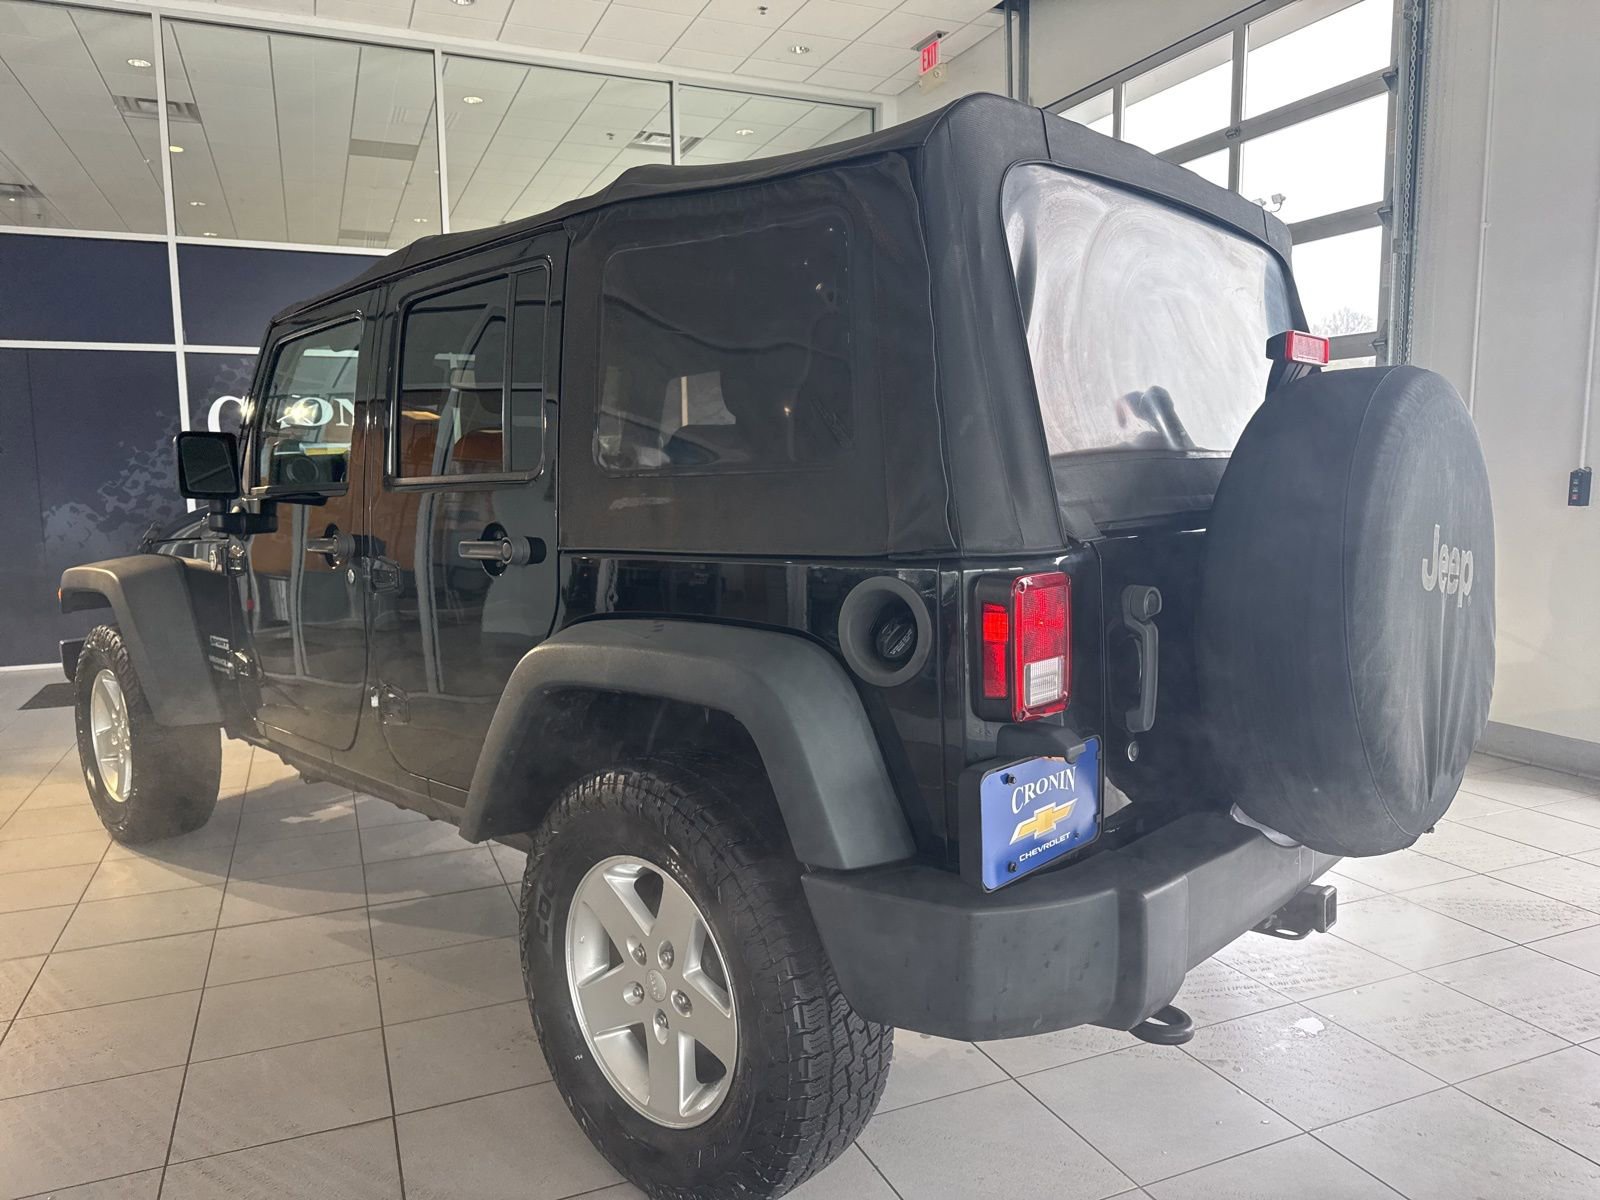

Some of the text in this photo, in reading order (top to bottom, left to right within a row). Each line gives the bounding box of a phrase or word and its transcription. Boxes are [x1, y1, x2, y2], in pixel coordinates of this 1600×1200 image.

[922, 41, 938, 72] EXIT
[1421, 523, 1474, 608] Jeep
[1011, 766, 1077, 815] CRONIN
[1018, 831, 1071, 862] CHEVROLET
